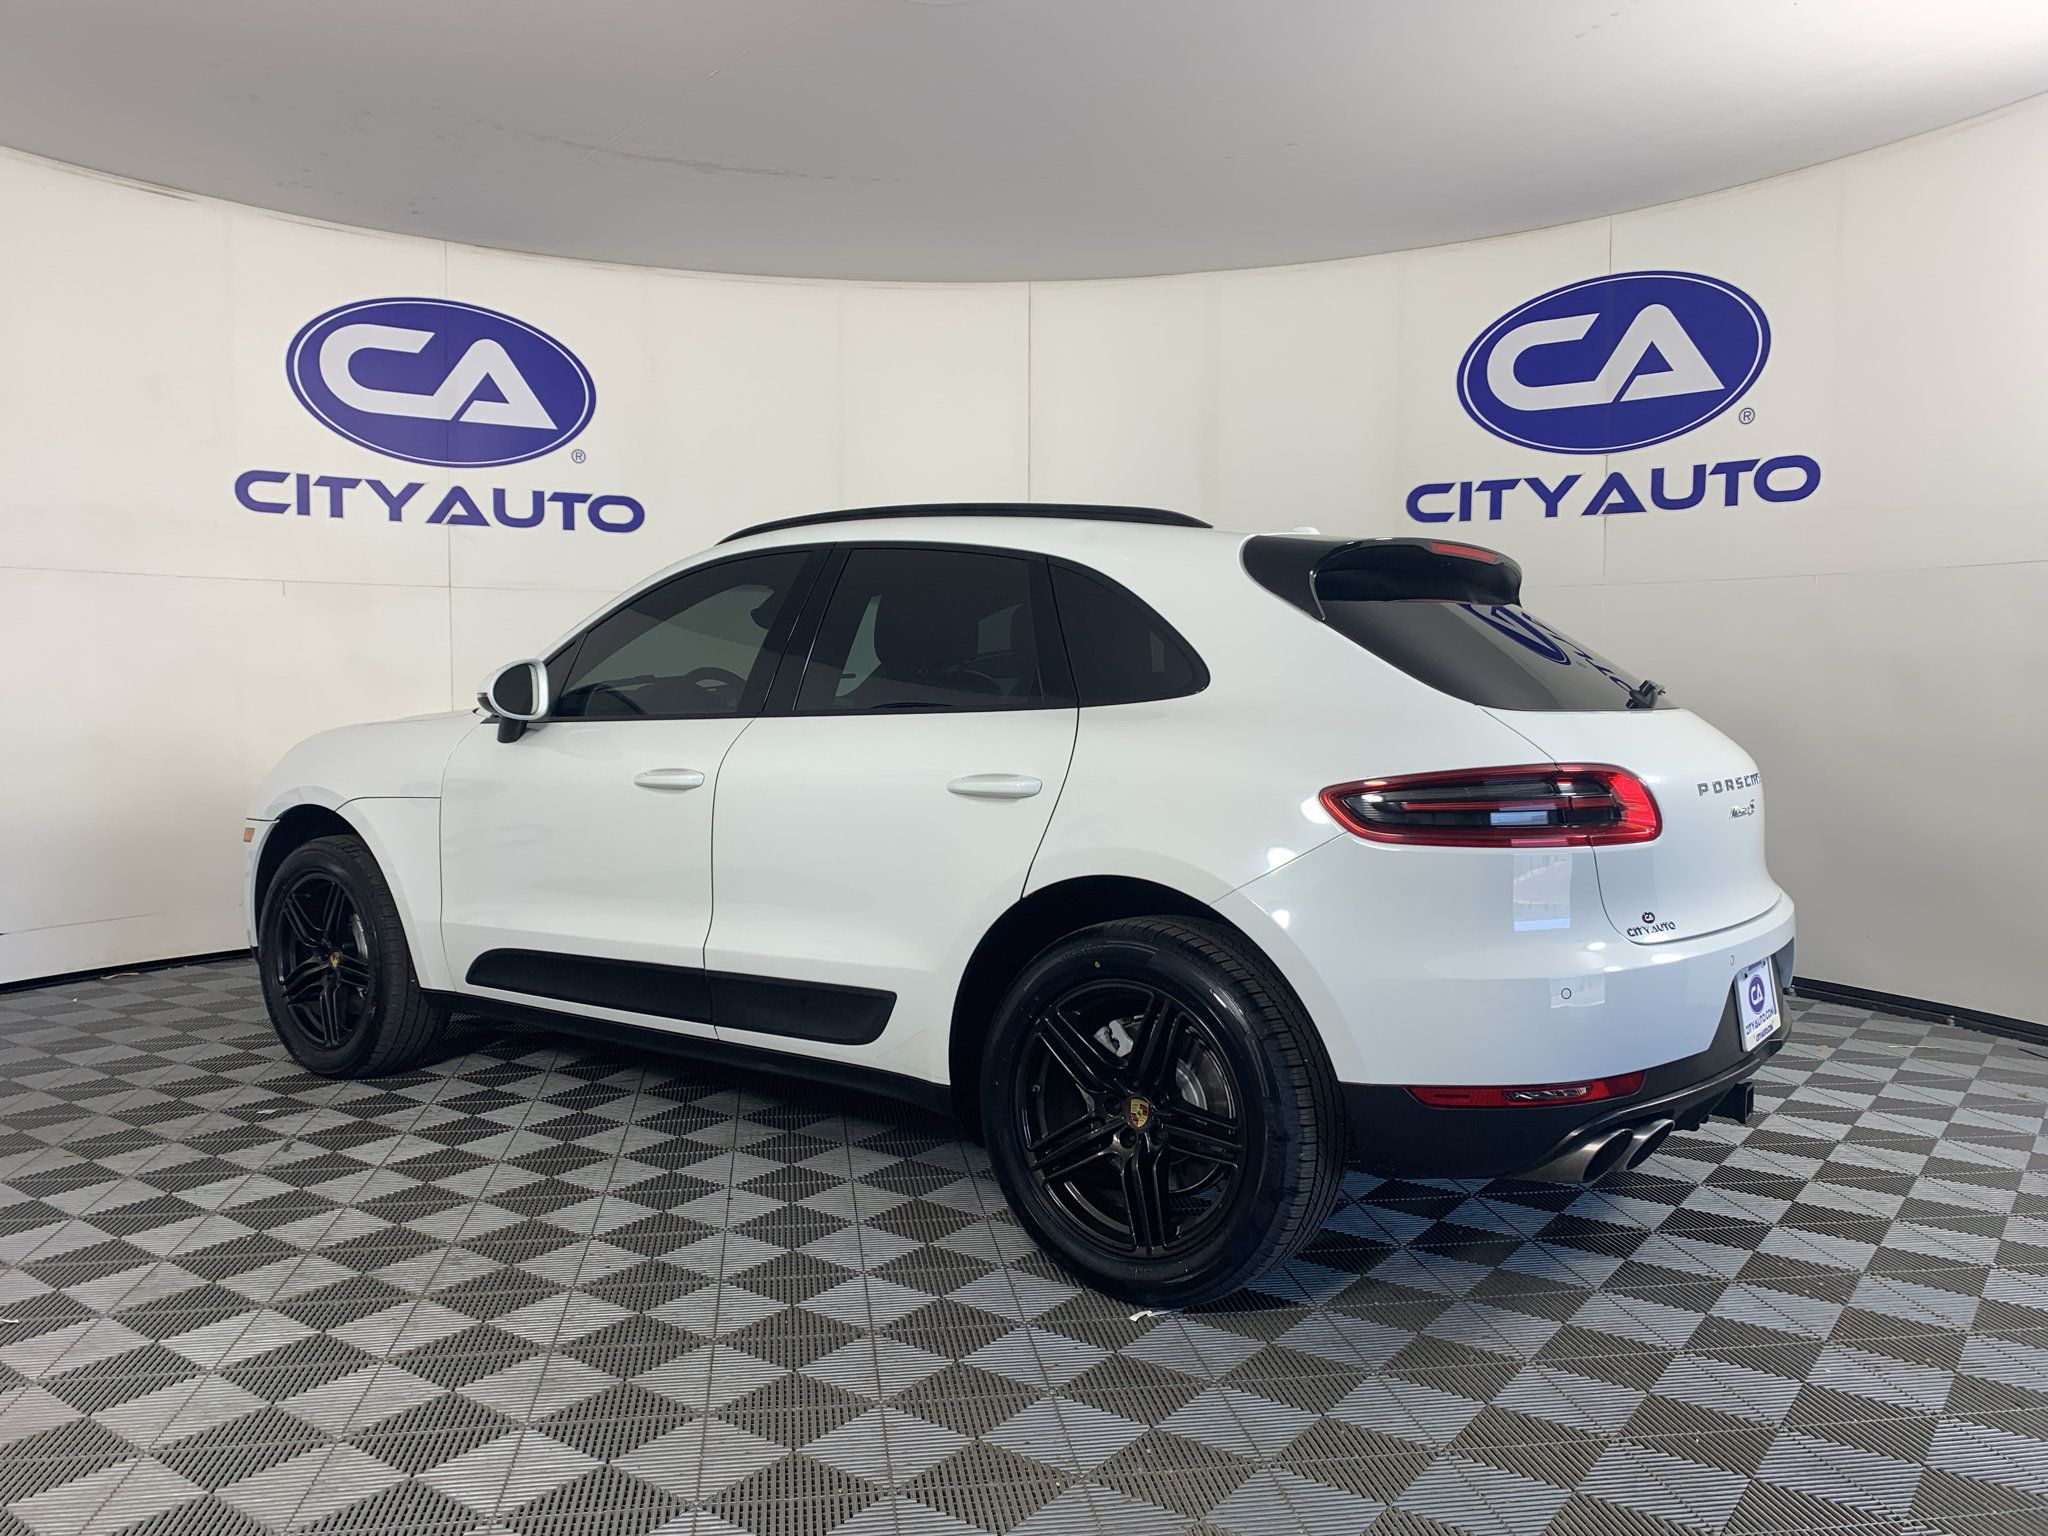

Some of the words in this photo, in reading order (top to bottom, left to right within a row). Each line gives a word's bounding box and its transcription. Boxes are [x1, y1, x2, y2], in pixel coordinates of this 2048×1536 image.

[319, 323, 559, 430] CA
[1486, 303, 1726, 412] CA
[234, 469, 427, 523] CITY
[425, 484, 646, 534] AUTO
[1405, 473, 1584, 523] CITY
[1580, 454, 1822, 517] AUTO
[1697, 773, 1761, 796] PORSC
[1627, 926, 1650, 937] CITY
[1651, 921, 1676, 933] AUTO
[1751, 984, 1764, 1006] CA
